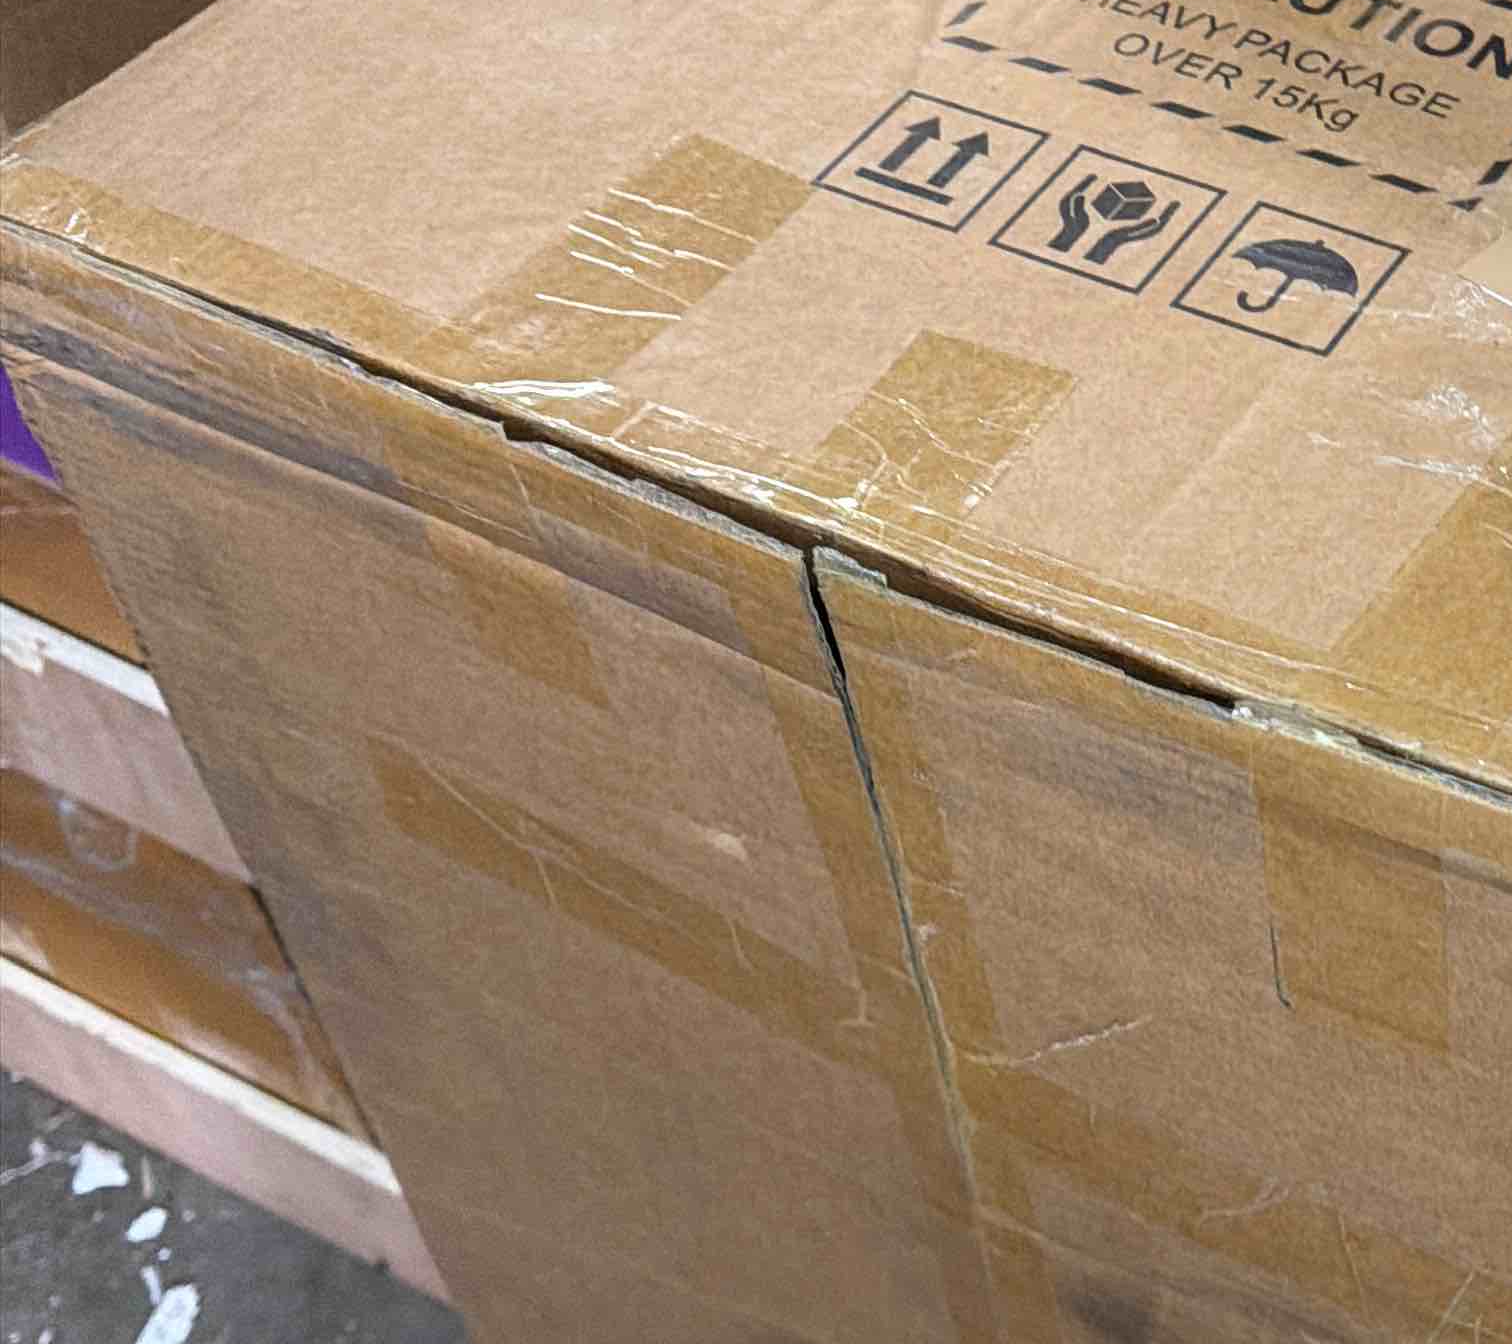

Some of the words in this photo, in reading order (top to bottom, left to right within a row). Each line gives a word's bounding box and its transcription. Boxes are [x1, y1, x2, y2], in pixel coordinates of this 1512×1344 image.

[1112, 31, 1245, 94] OVER
[1253, 75, 1360, 134] 15Kg
[1231, 27, 1463, 120] PACKAGE
